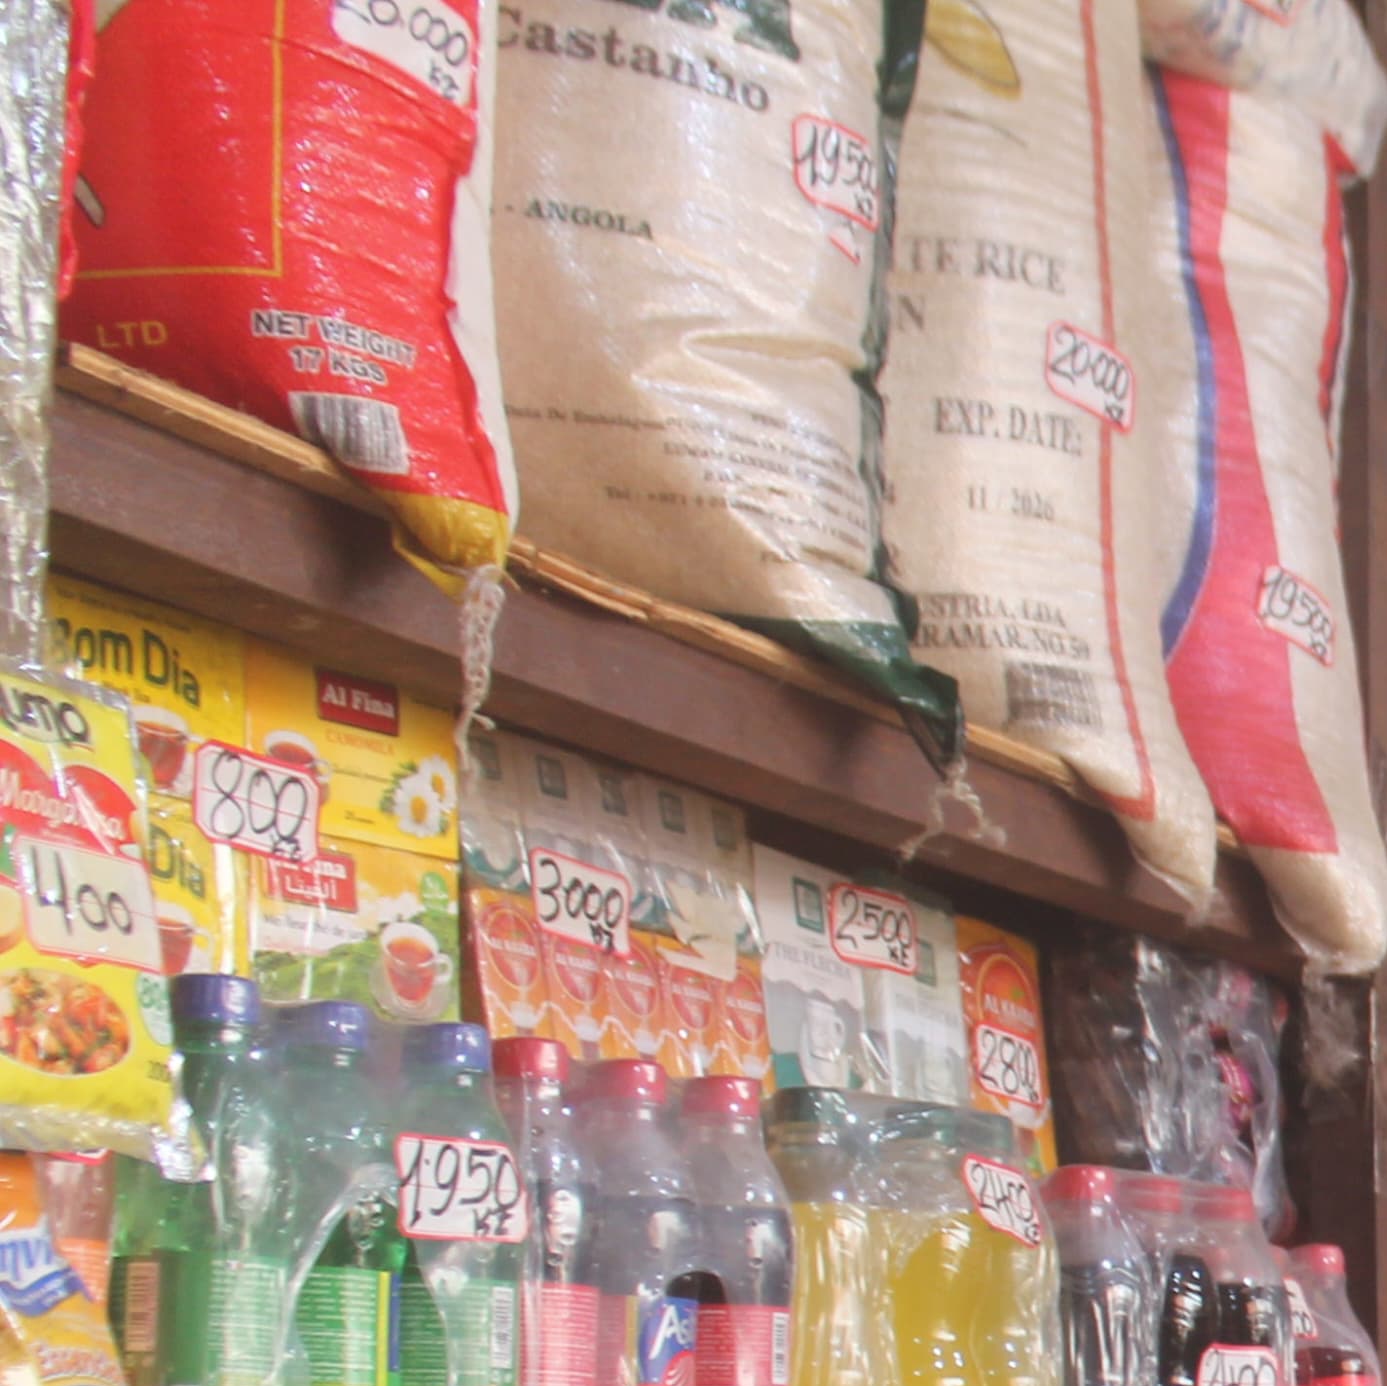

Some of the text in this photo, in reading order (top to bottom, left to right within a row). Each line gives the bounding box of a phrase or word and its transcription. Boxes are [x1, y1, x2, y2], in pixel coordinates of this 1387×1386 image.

[496, 9, 770, 112] Castanho
[524, 198, 653, 240] ANGOLA
[973, 241, 1066, 294] RICE
[99, 320, 167, 351] LTD
[252, 311, 415, 367] NET WEIGHT
[290, 349, 387, 385] 17 KGS
[935, 396, 1082, 458] EXP. DATE:
[142, 627, 201, 707] Dia
[322, 683, 396, 720] Al Fina
[210, 749, 309, 839] 800
[29, 838, 133, 937] 400
